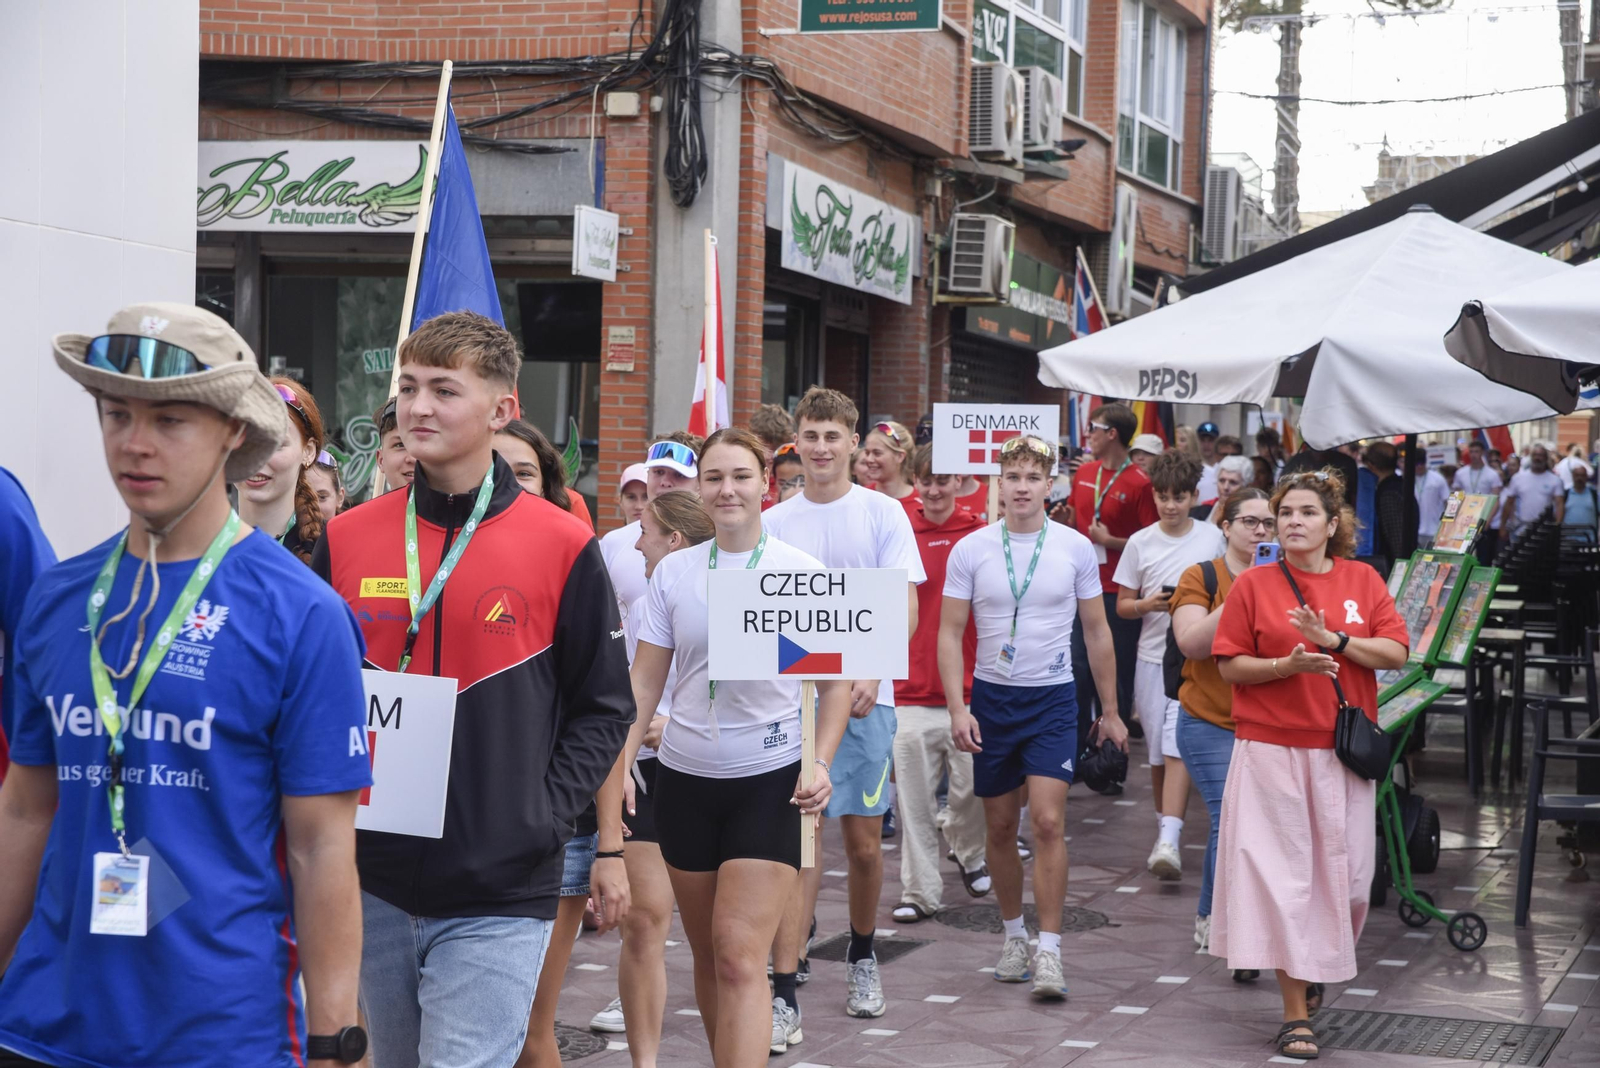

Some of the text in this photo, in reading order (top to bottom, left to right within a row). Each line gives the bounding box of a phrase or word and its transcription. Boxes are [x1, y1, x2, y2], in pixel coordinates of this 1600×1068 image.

[819, 11, 917, 24] www.rejosusa.com
[268, 208, 358, 227] Peluquería
[1137, 367, 1198, 400] PEPSI
[952, 414, 1040, 430] DENMARK
[760, 573, 845, 596] CZECH
[744, 609, 873, 633] REPUBLIC
[164, 661, 205, 677] AUSTRIA
[367, 694, 402, 730] M
[763, 732, 788, 745] CZECH
[149, 763, 210, 792] Kraft.
